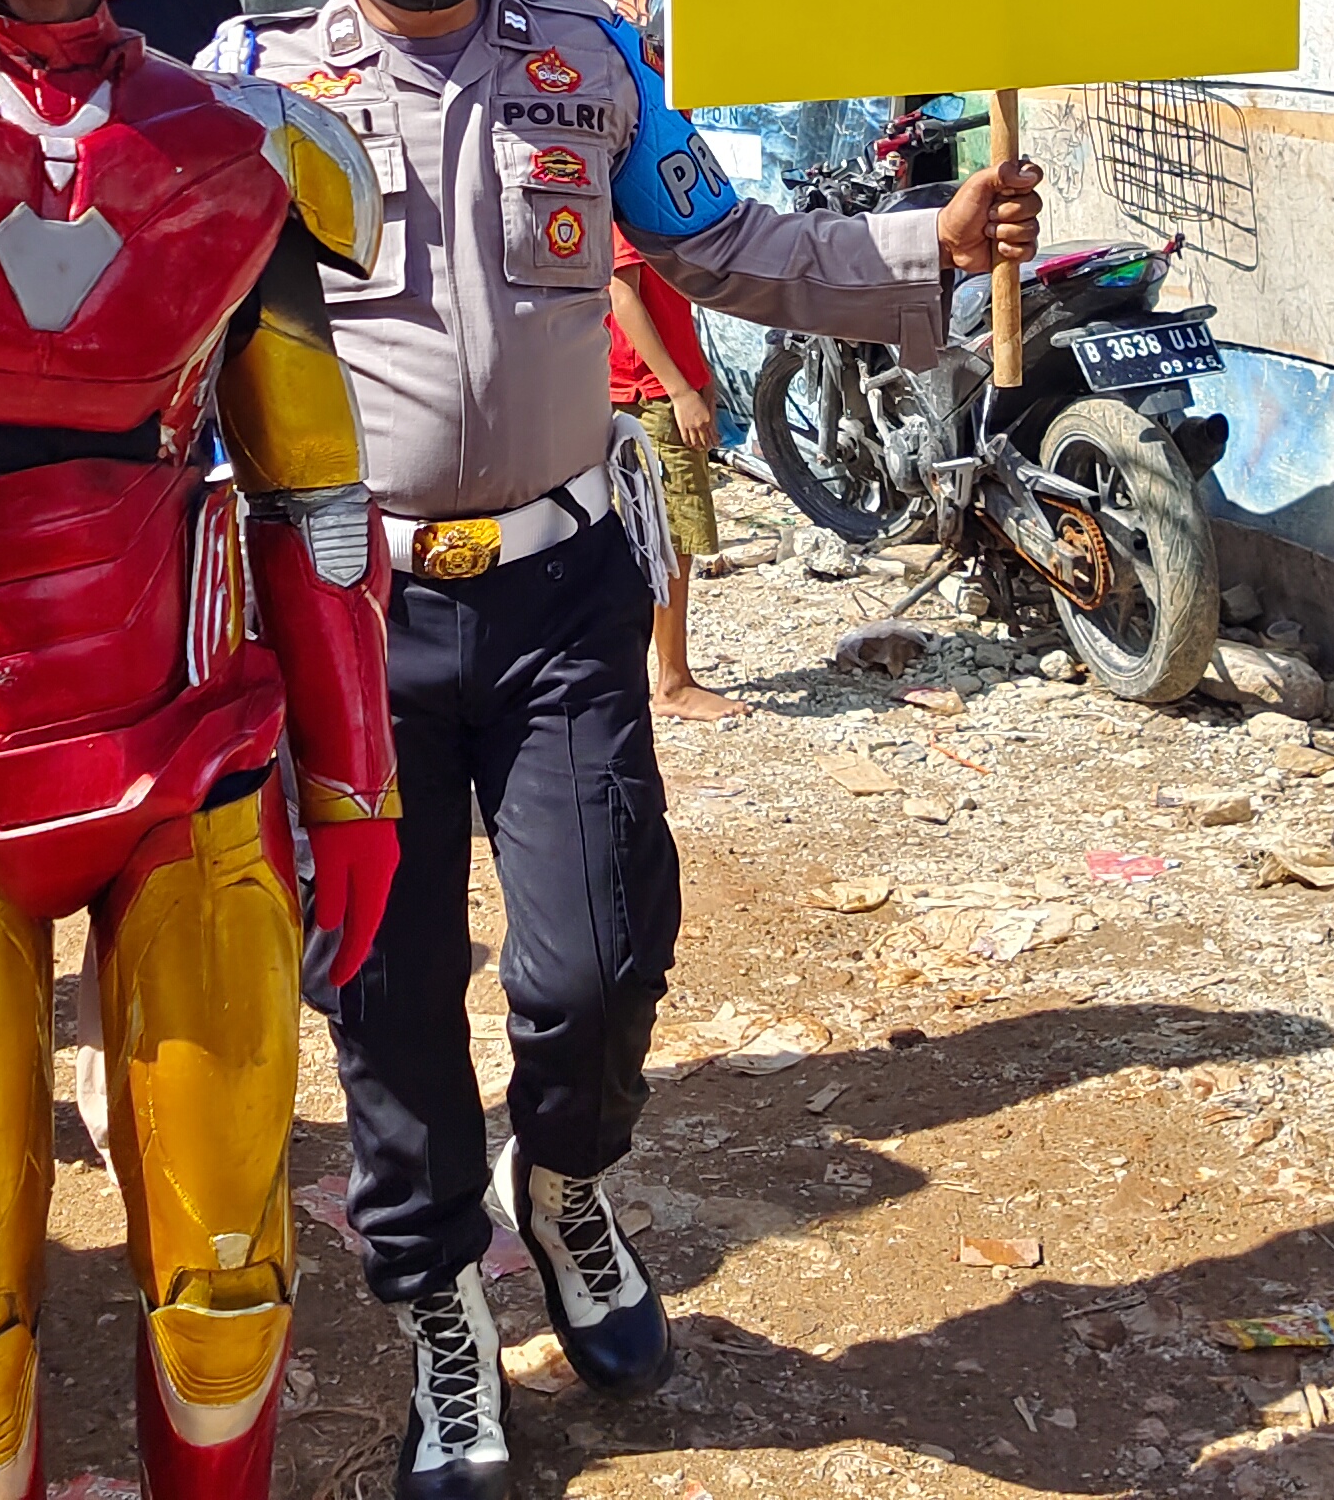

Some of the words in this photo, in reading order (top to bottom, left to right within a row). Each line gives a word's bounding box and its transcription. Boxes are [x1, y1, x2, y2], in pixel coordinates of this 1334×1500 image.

[503, 102, 605, 132] POLRI
[1083, 342, 1102, 363] B
[1106, 333, 1163, 361] 3638
[1168, 324, 1211, 351] UJJ
